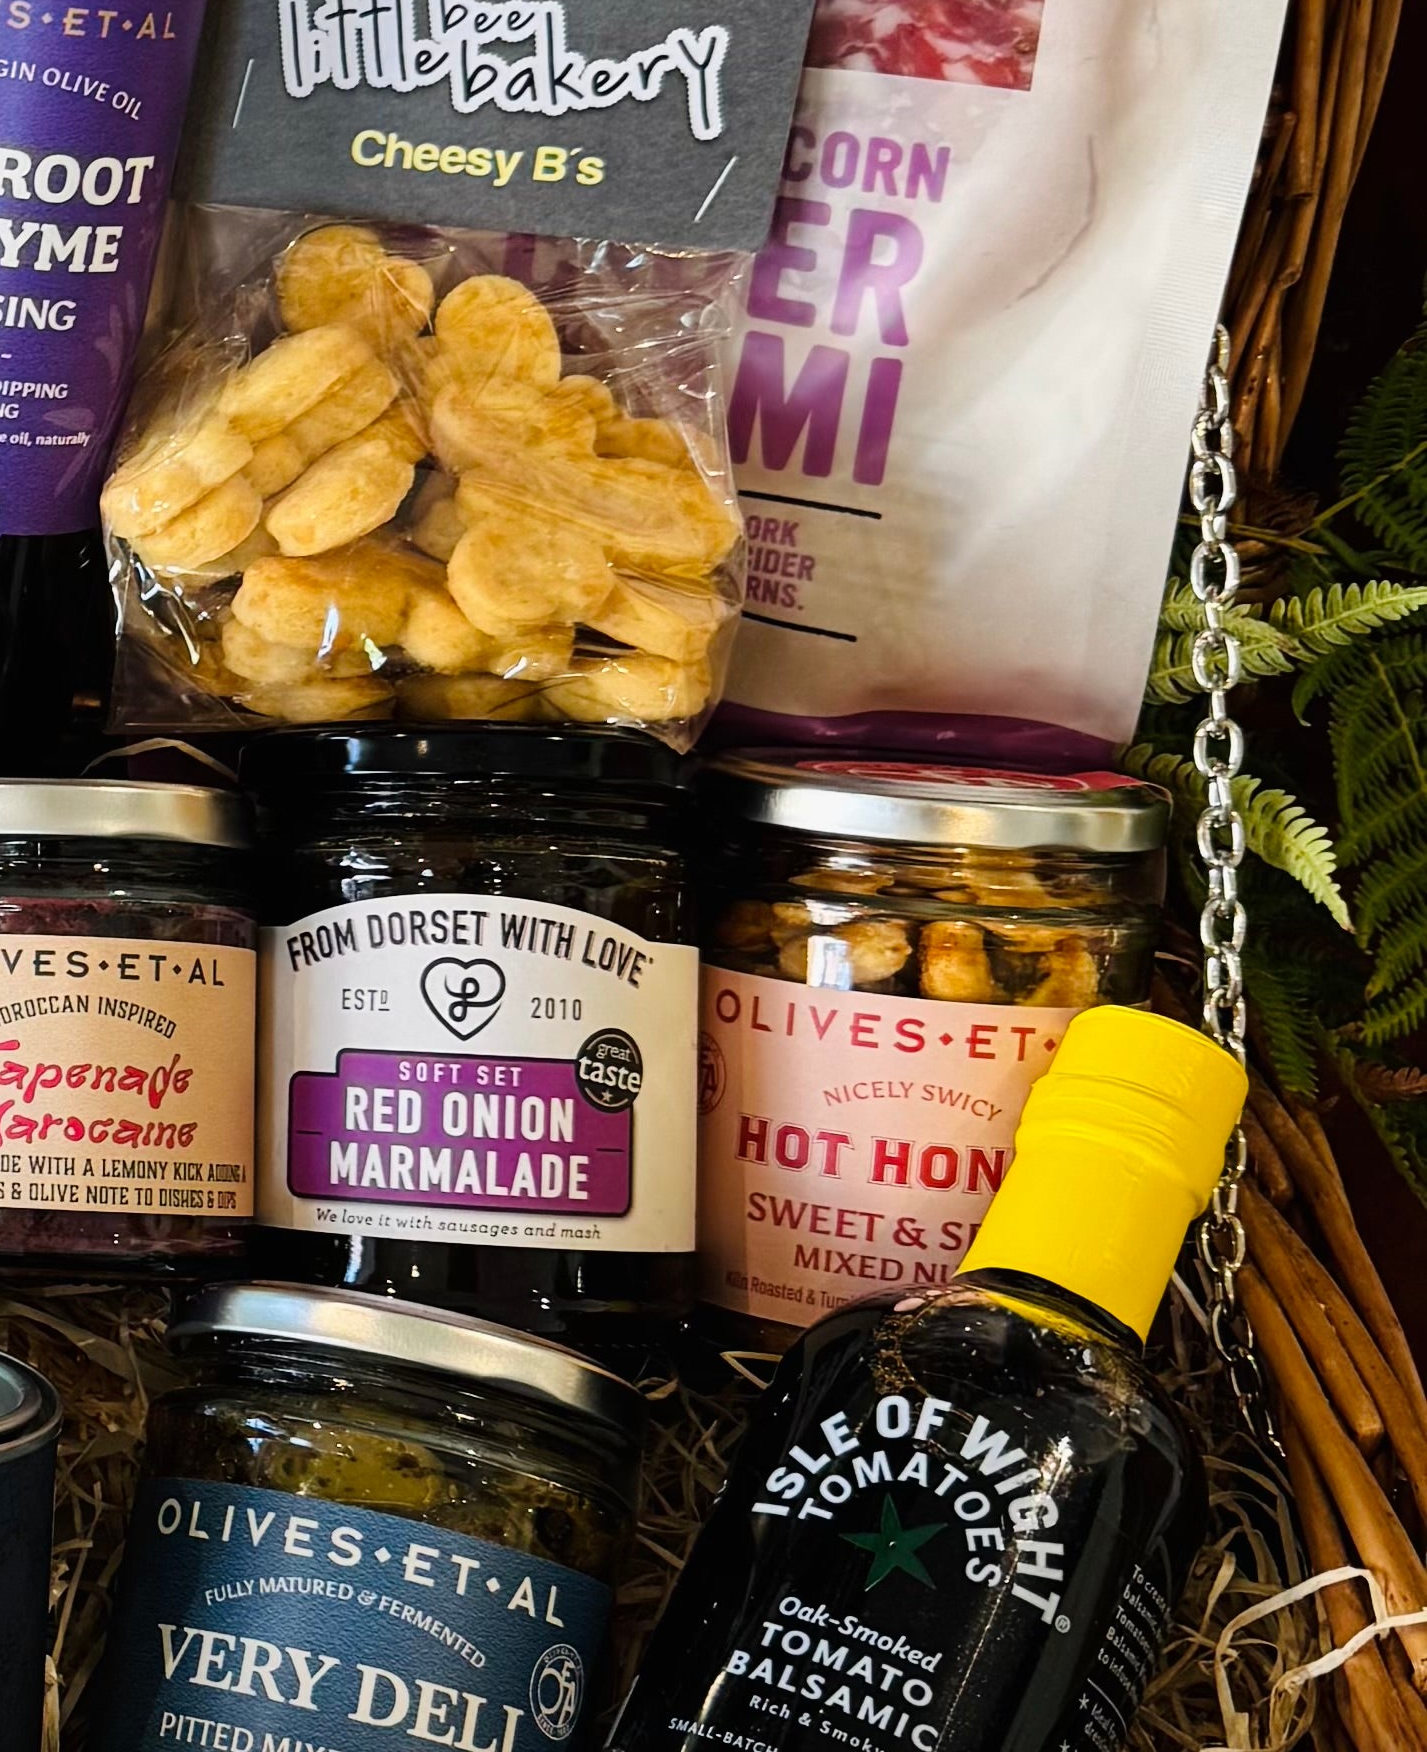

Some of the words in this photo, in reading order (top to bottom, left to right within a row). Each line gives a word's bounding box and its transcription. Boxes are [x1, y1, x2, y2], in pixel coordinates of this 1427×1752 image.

[455, 32, 724, 134] bakery
[351, 129, 523, 190] Cheesy
[97, 996, 177, 1039] INSPIRED
[578, 1056, 640, 1093] taste
[823, 1080, 914, 1107] NICELY
[921, 1084, 1002, 1122] SWICY
[346, 1087, 422, 1134] RED
[443, 1092, 574, 1143] ONION
[735, 1112, 855, 1179] HOT
[28, 1155, 75, 1176] WITH
[82, 1159, 95, 1177] A
[102, 1159, 169, 1181] LEMONY
[173, 1162, 203, 1182] KICK
[329, 1140, 590, 1201] MARMALADE
[751, 1411, 862, 1518] ISLE
[875, 1395, 953, 1441] OF
[957, 1414, 1065, 1627] WIGHT
[798, 1450, 1006, 1590] TOMATOES
[760, 1622, 934, 1708] TOMATO
[778, 1596, 942, 1673] Oak-Smoked
[157, 1623, 341, 1711] VERY
